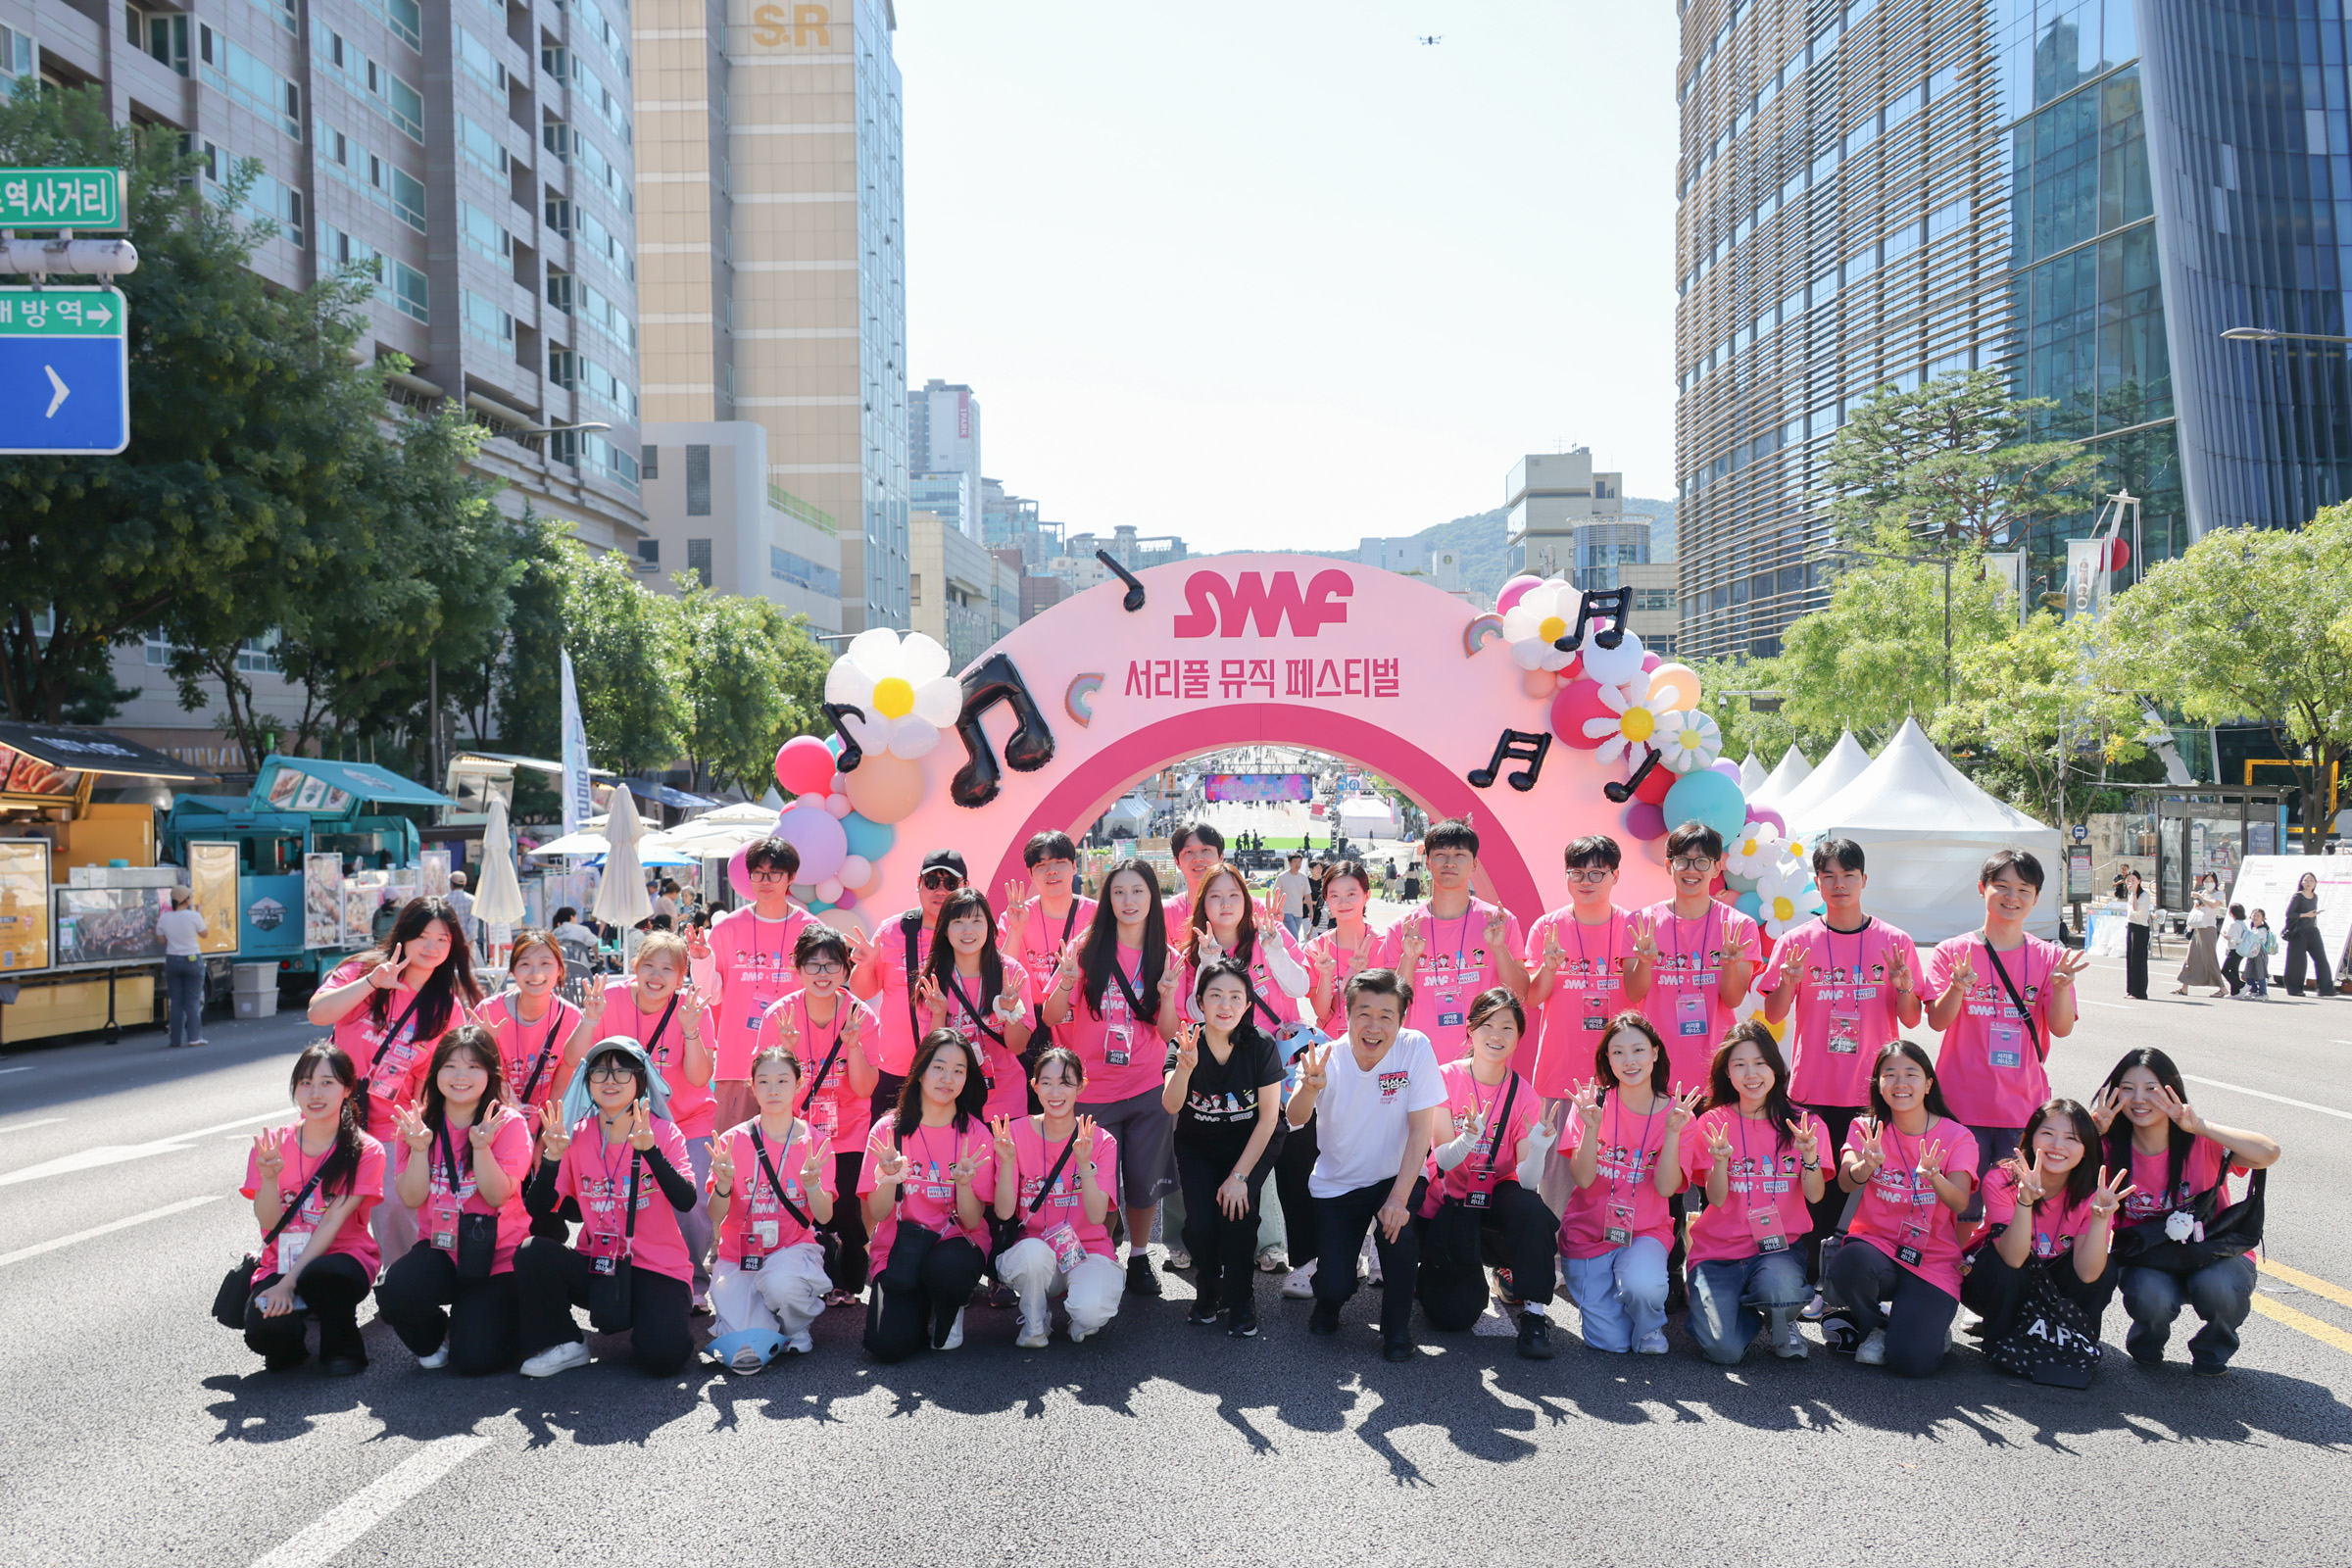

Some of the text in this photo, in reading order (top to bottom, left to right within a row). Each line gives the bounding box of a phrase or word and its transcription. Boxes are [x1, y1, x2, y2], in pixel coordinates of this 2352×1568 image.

[0, 177, 107, 217] 역사거리
[1125, 658, 1399, 699] 서리풀 뮤직 페스티벌
[1379, 1077, 1410, 1091] 전성수
